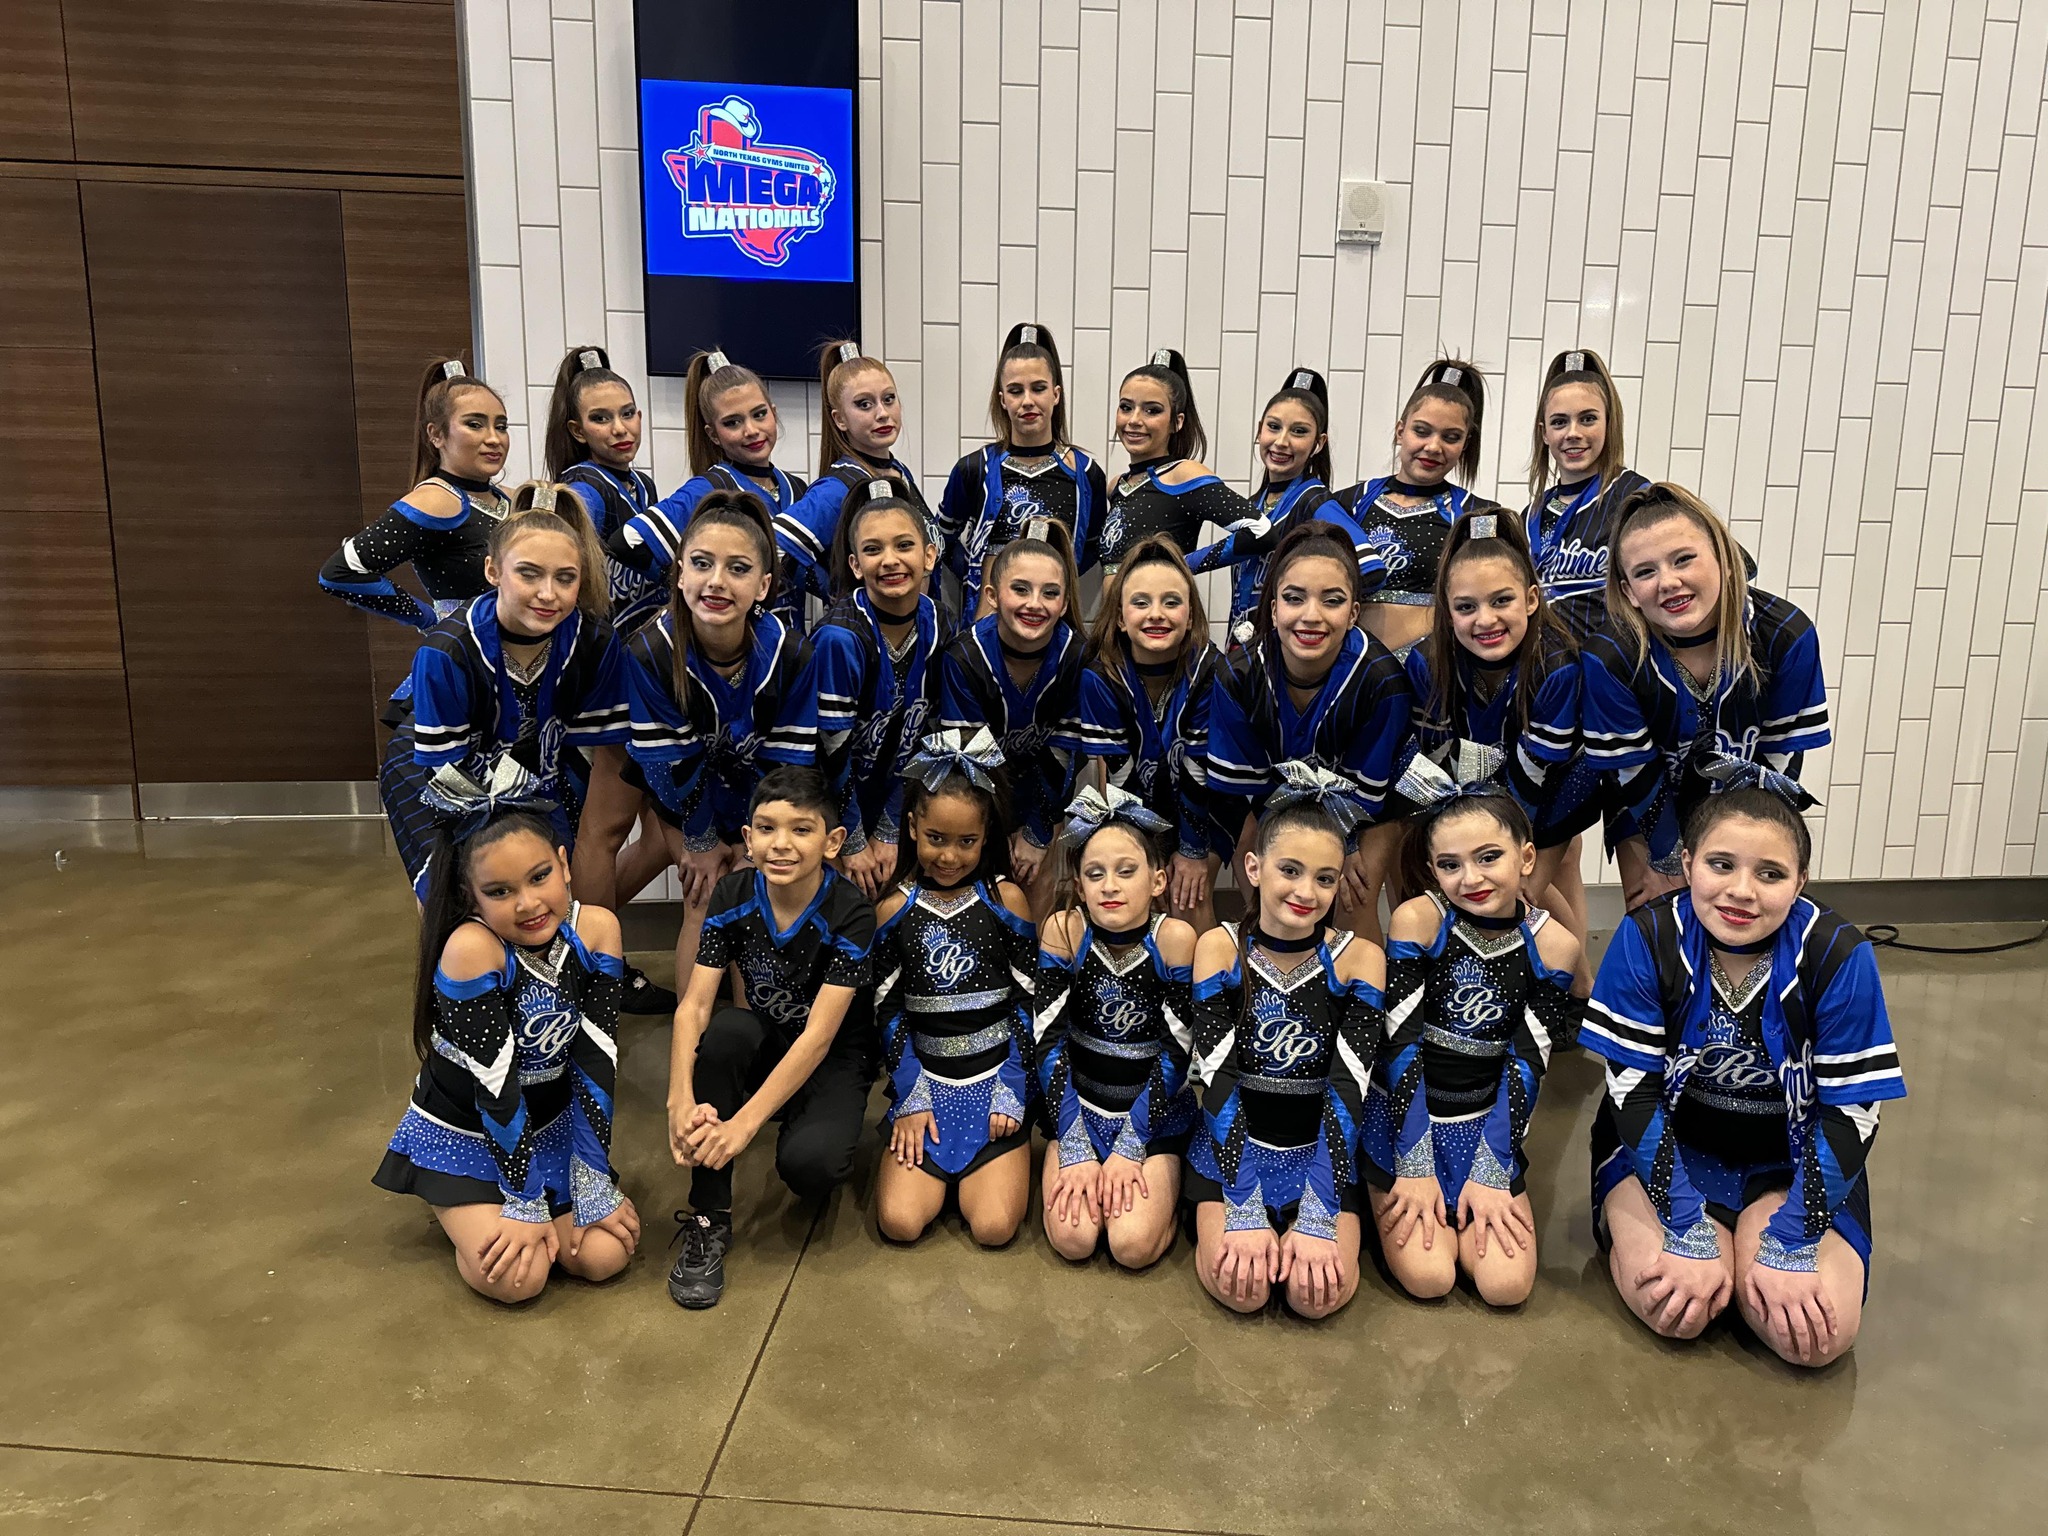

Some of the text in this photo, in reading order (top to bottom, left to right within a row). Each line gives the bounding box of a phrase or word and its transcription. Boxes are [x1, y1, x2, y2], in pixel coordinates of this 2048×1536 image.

[712, 148, 810, 172] NORTH TEXAS GYMS UNITED
[686, 158, 823, 209] MEGA
[688, 206, 820, 232] NATIONALS
